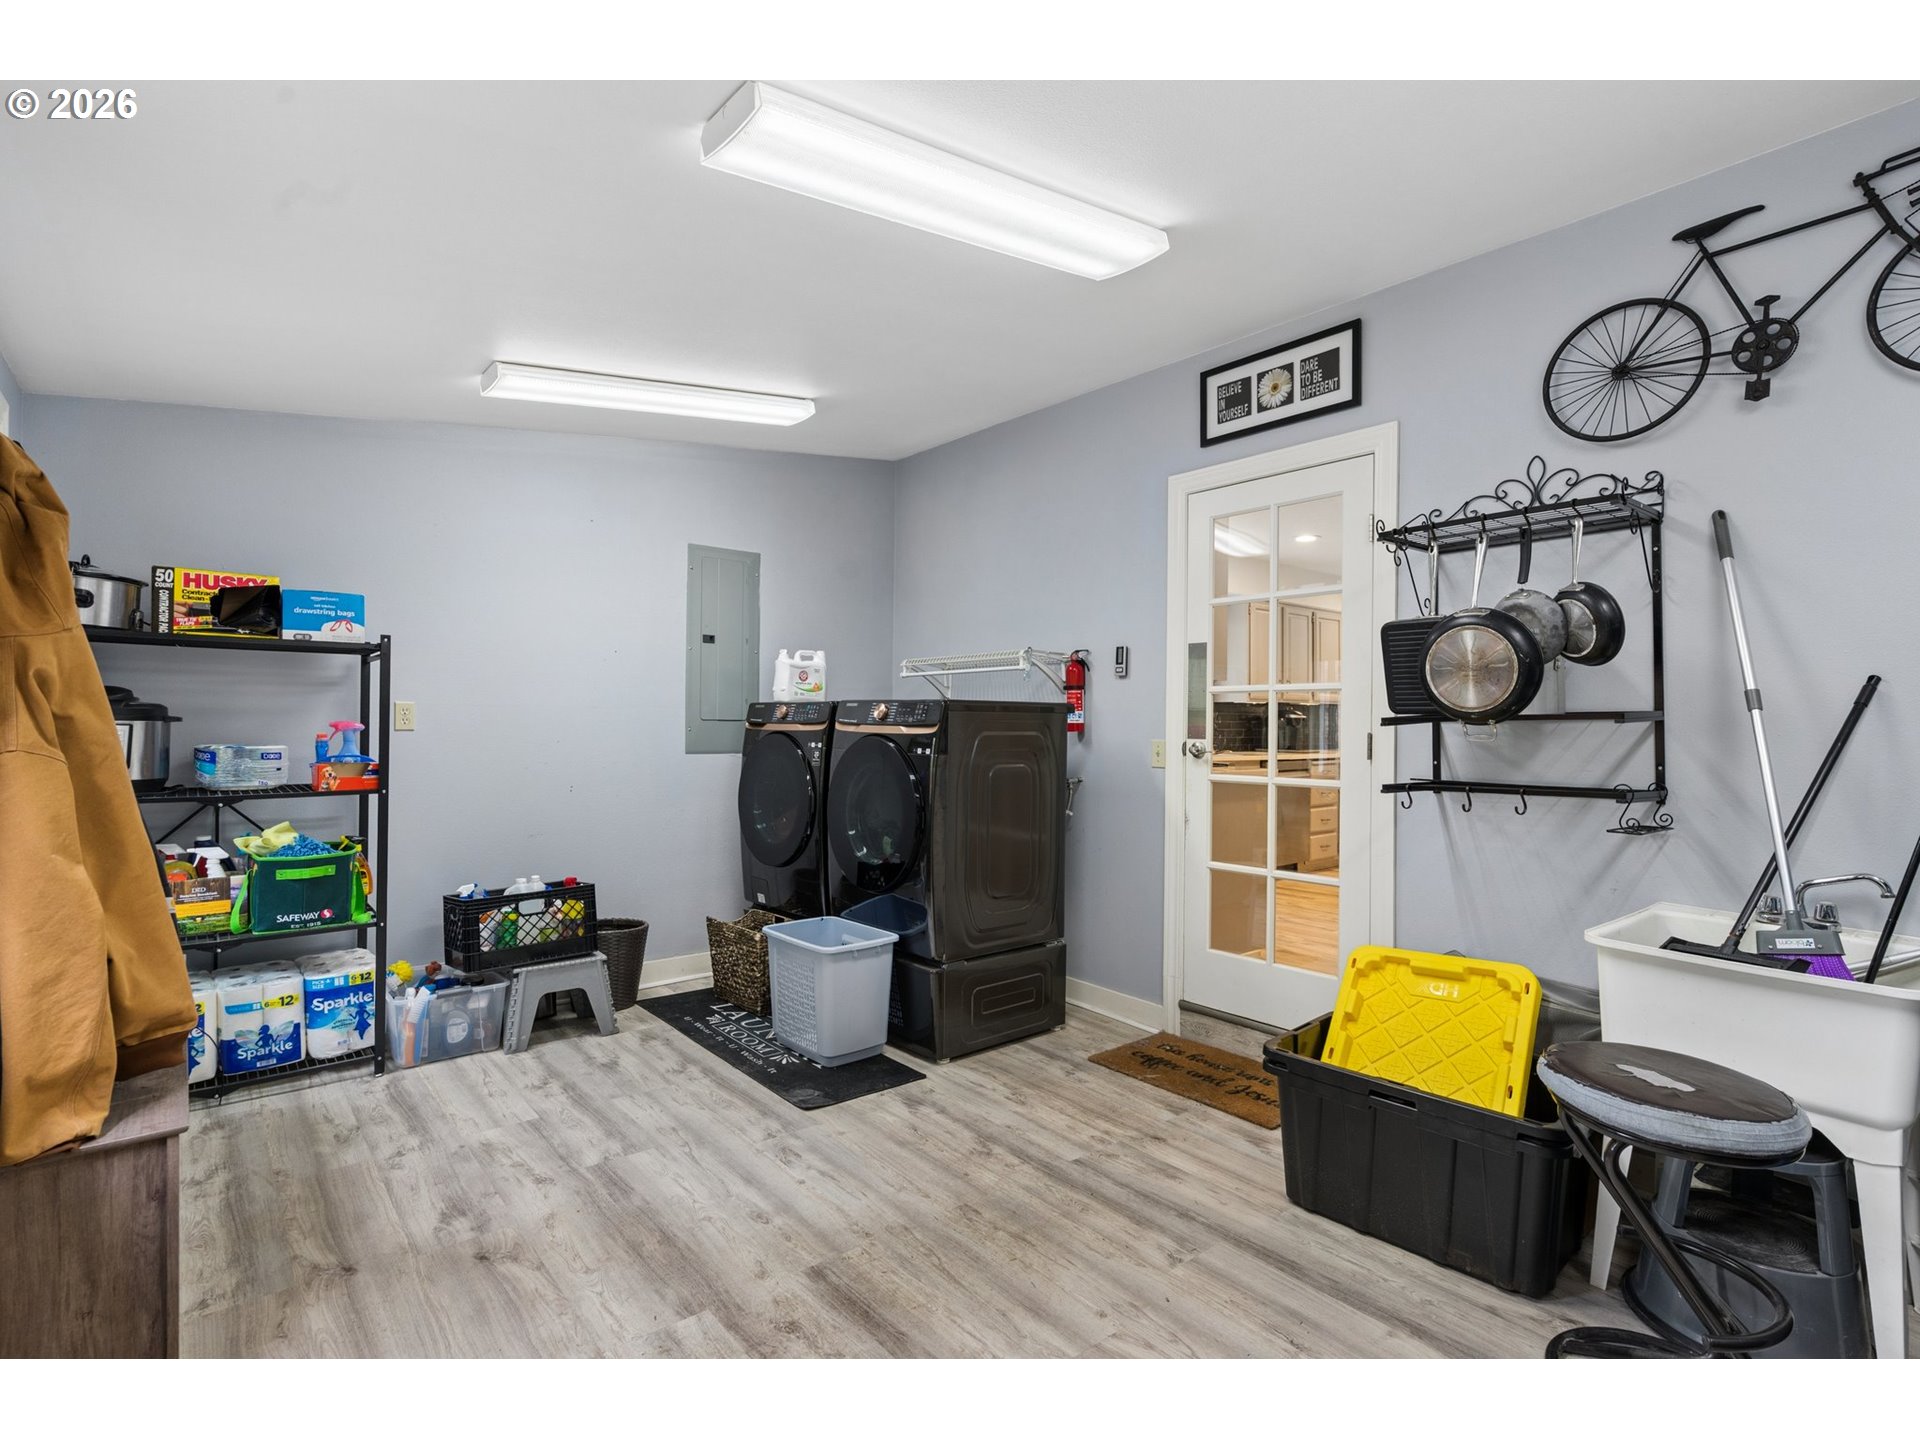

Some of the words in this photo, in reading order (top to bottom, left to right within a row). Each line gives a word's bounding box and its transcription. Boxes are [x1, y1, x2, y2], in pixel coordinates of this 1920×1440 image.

[1301, 357, 1319, 374] DARE
[1300, 372, 1311, 387] TO
[1312, 369, 1323, 384] BE
[1218, 381, 1242, 400] BELIEVE
[1300, 377, 1339, 400] DIFFERENT
[1218, 398, 1226, 411] IN
[1218, 403, 1249, 423] YOURSELF
[155, 568, 174, 583] 50
[181, 588, 219, 597] Contract
[158, 589, 170, 622] CONTRACTOR
[293, 606, 336, 617] drawstring
[337, 609, 356, 618] bags
[158, 622, 170, 634] PAC
[276, 910, 321, 924] SAFEWAY
[359, 971, 372, 981] 12
[263, 1000, 270, 1008] 6
[278, 995, 294, 1007] 12
[311, 991, 373, 1014] Sparkle
[719, 1024, 775, 1053] ROOM
[237, 1040, 293, 1061] Sparkle
[1186, 1069, 1236, 1087] and
[1224, 1085, 1280, 1108] Jesu
